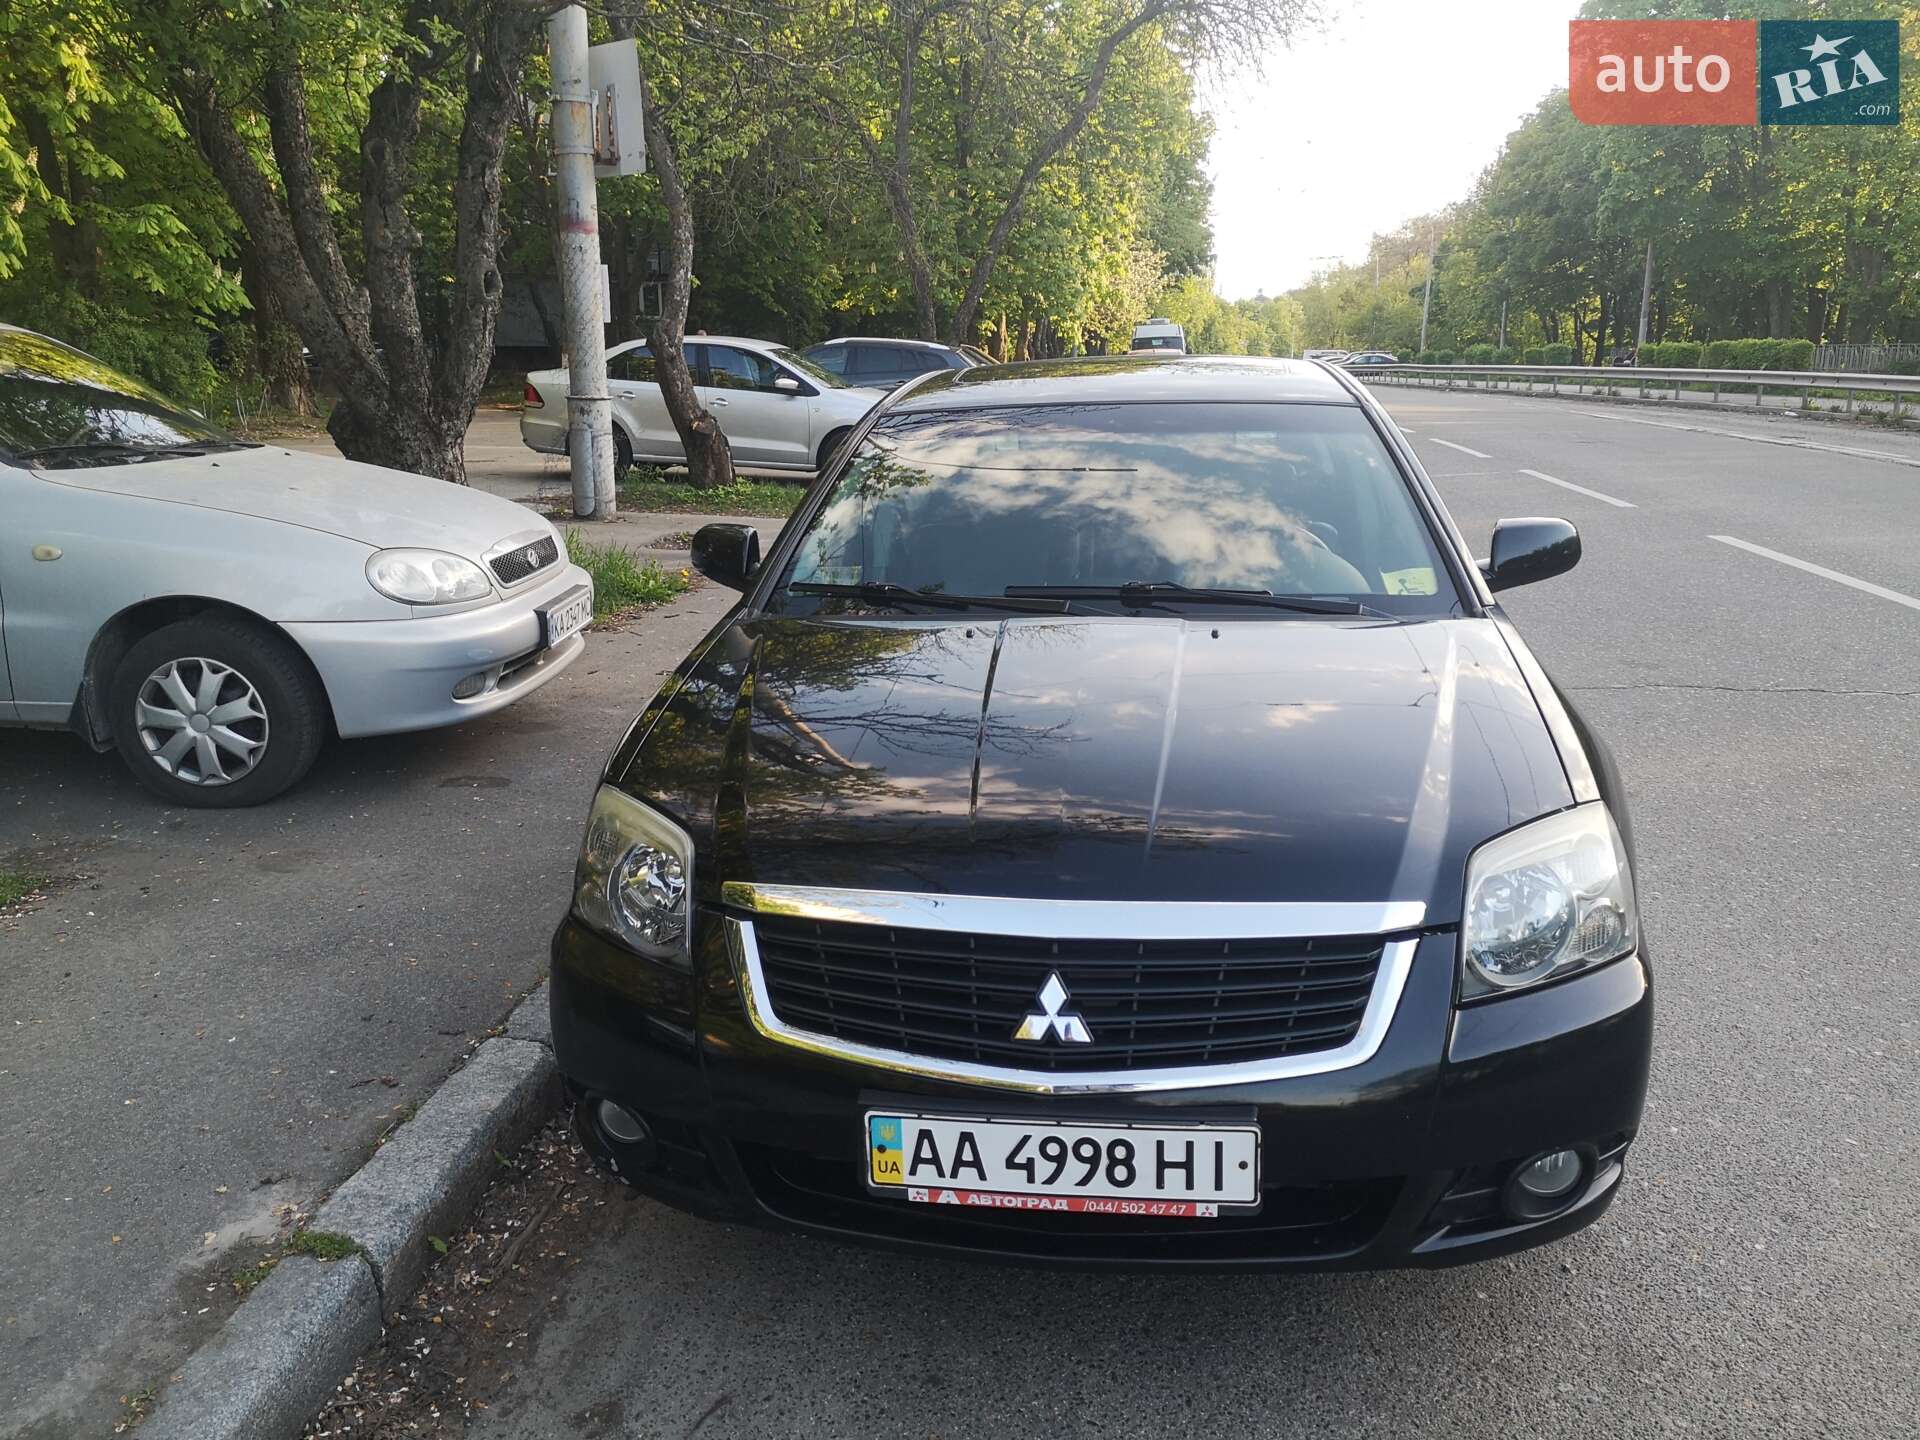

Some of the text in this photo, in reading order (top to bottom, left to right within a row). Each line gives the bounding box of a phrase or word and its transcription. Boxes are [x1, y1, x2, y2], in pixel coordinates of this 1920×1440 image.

[877, 1160, 900, 1174] UA
[908, 1128, 1224, 1192] AA 4998 HI
[967, 1193, 1069, 1210] АВТОГРАД
[1083, 1200, 1187, 1216] /044/ 502 47 47
